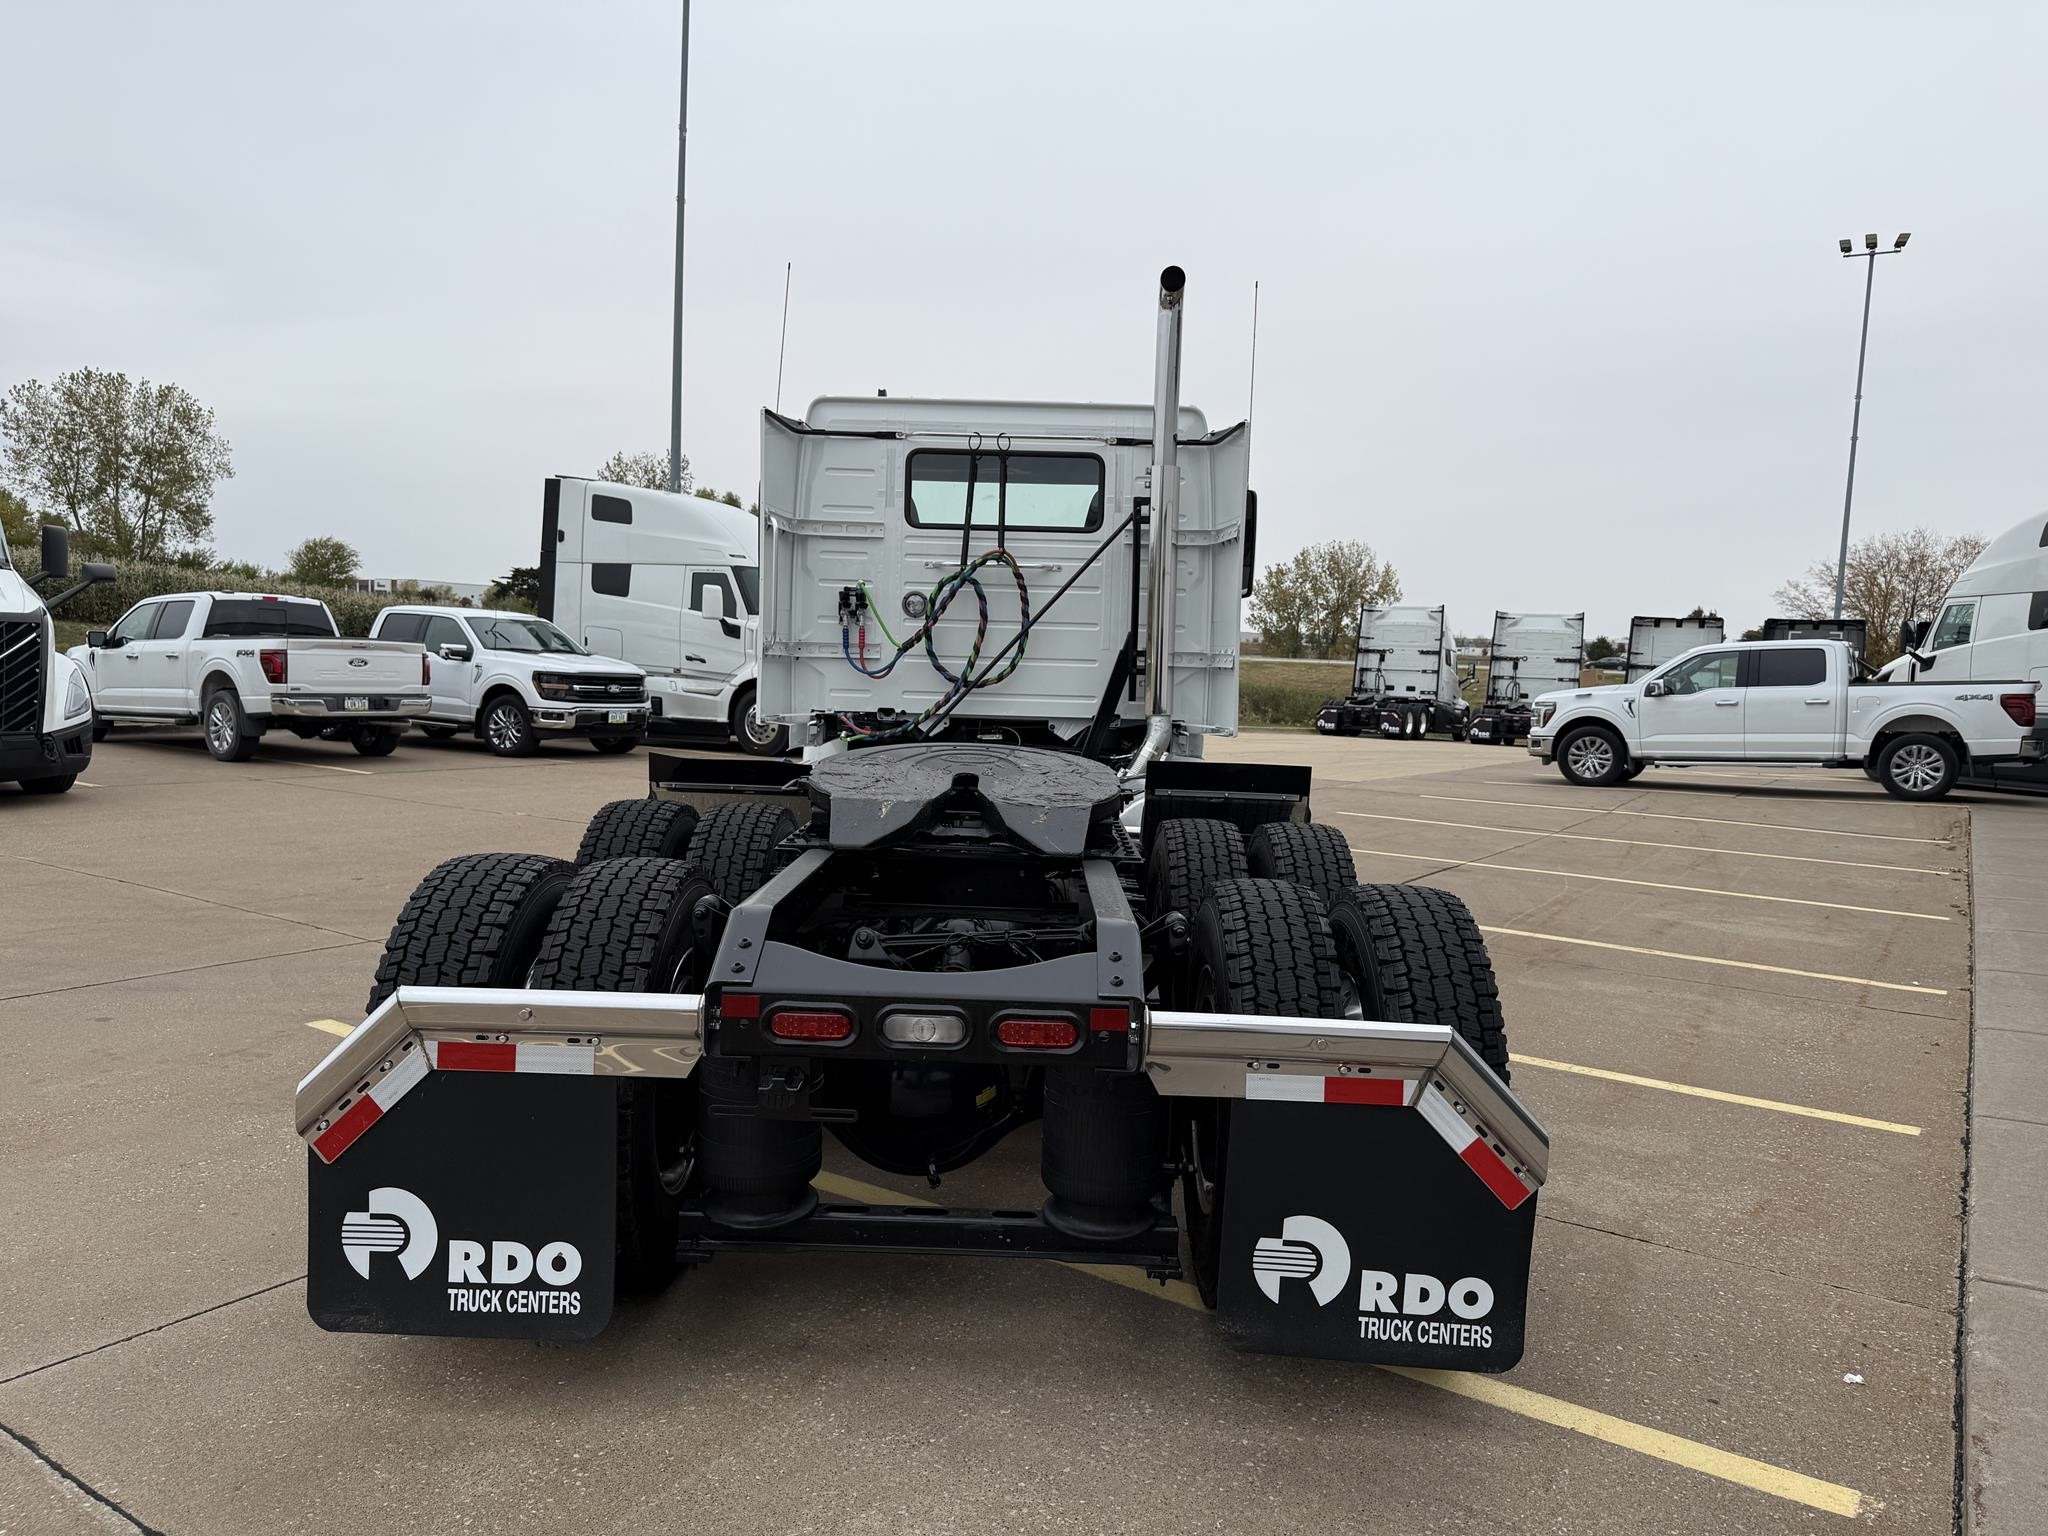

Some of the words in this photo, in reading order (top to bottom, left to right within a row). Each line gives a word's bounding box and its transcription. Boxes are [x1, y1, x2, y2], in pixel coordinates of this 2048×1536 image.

[447, 1239, 583, 1286] RDO
[447, 1288, 503, 1314] TRUCK
[506, 1290, 582, 1316] CENTERS
[1358, 1269, 1496, 1320] RDO
[1358, 1316, 1414, 1343] TRUCK
[1416, 1320, 1493, 1349] CENTERS
